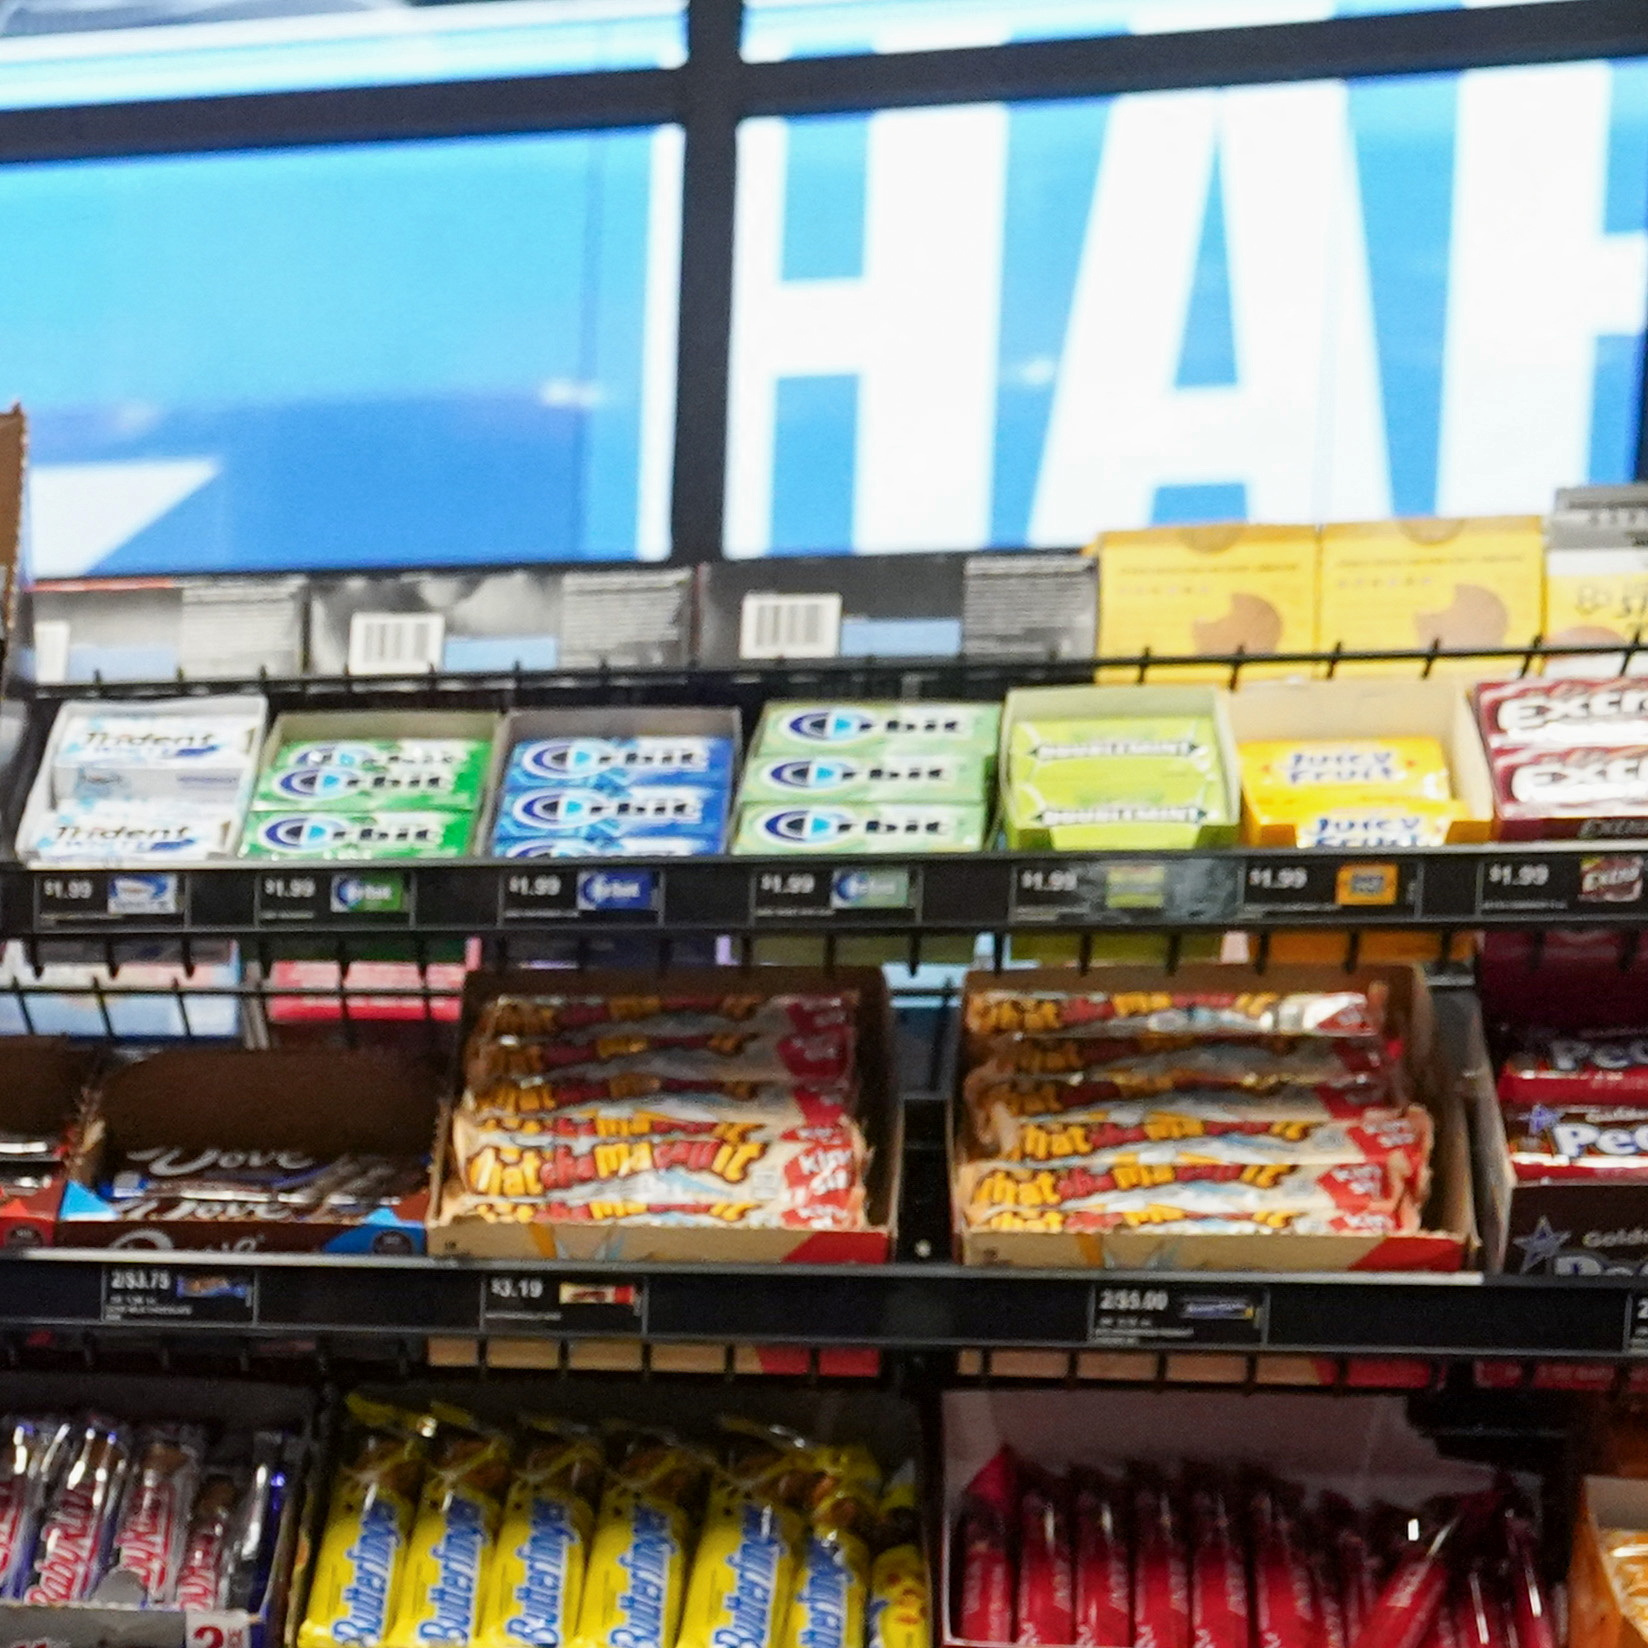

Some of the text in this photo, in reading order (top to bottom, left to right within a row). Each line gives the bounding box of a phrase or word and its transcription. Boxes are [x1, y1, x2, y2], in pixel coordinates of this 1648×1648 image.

[766, 757, 947, 791] Orbit
[519, 789, 700, 826] Orbit
[761, 807, 945, 843] Orbit
[261, 815, 442, 853] Orbit
